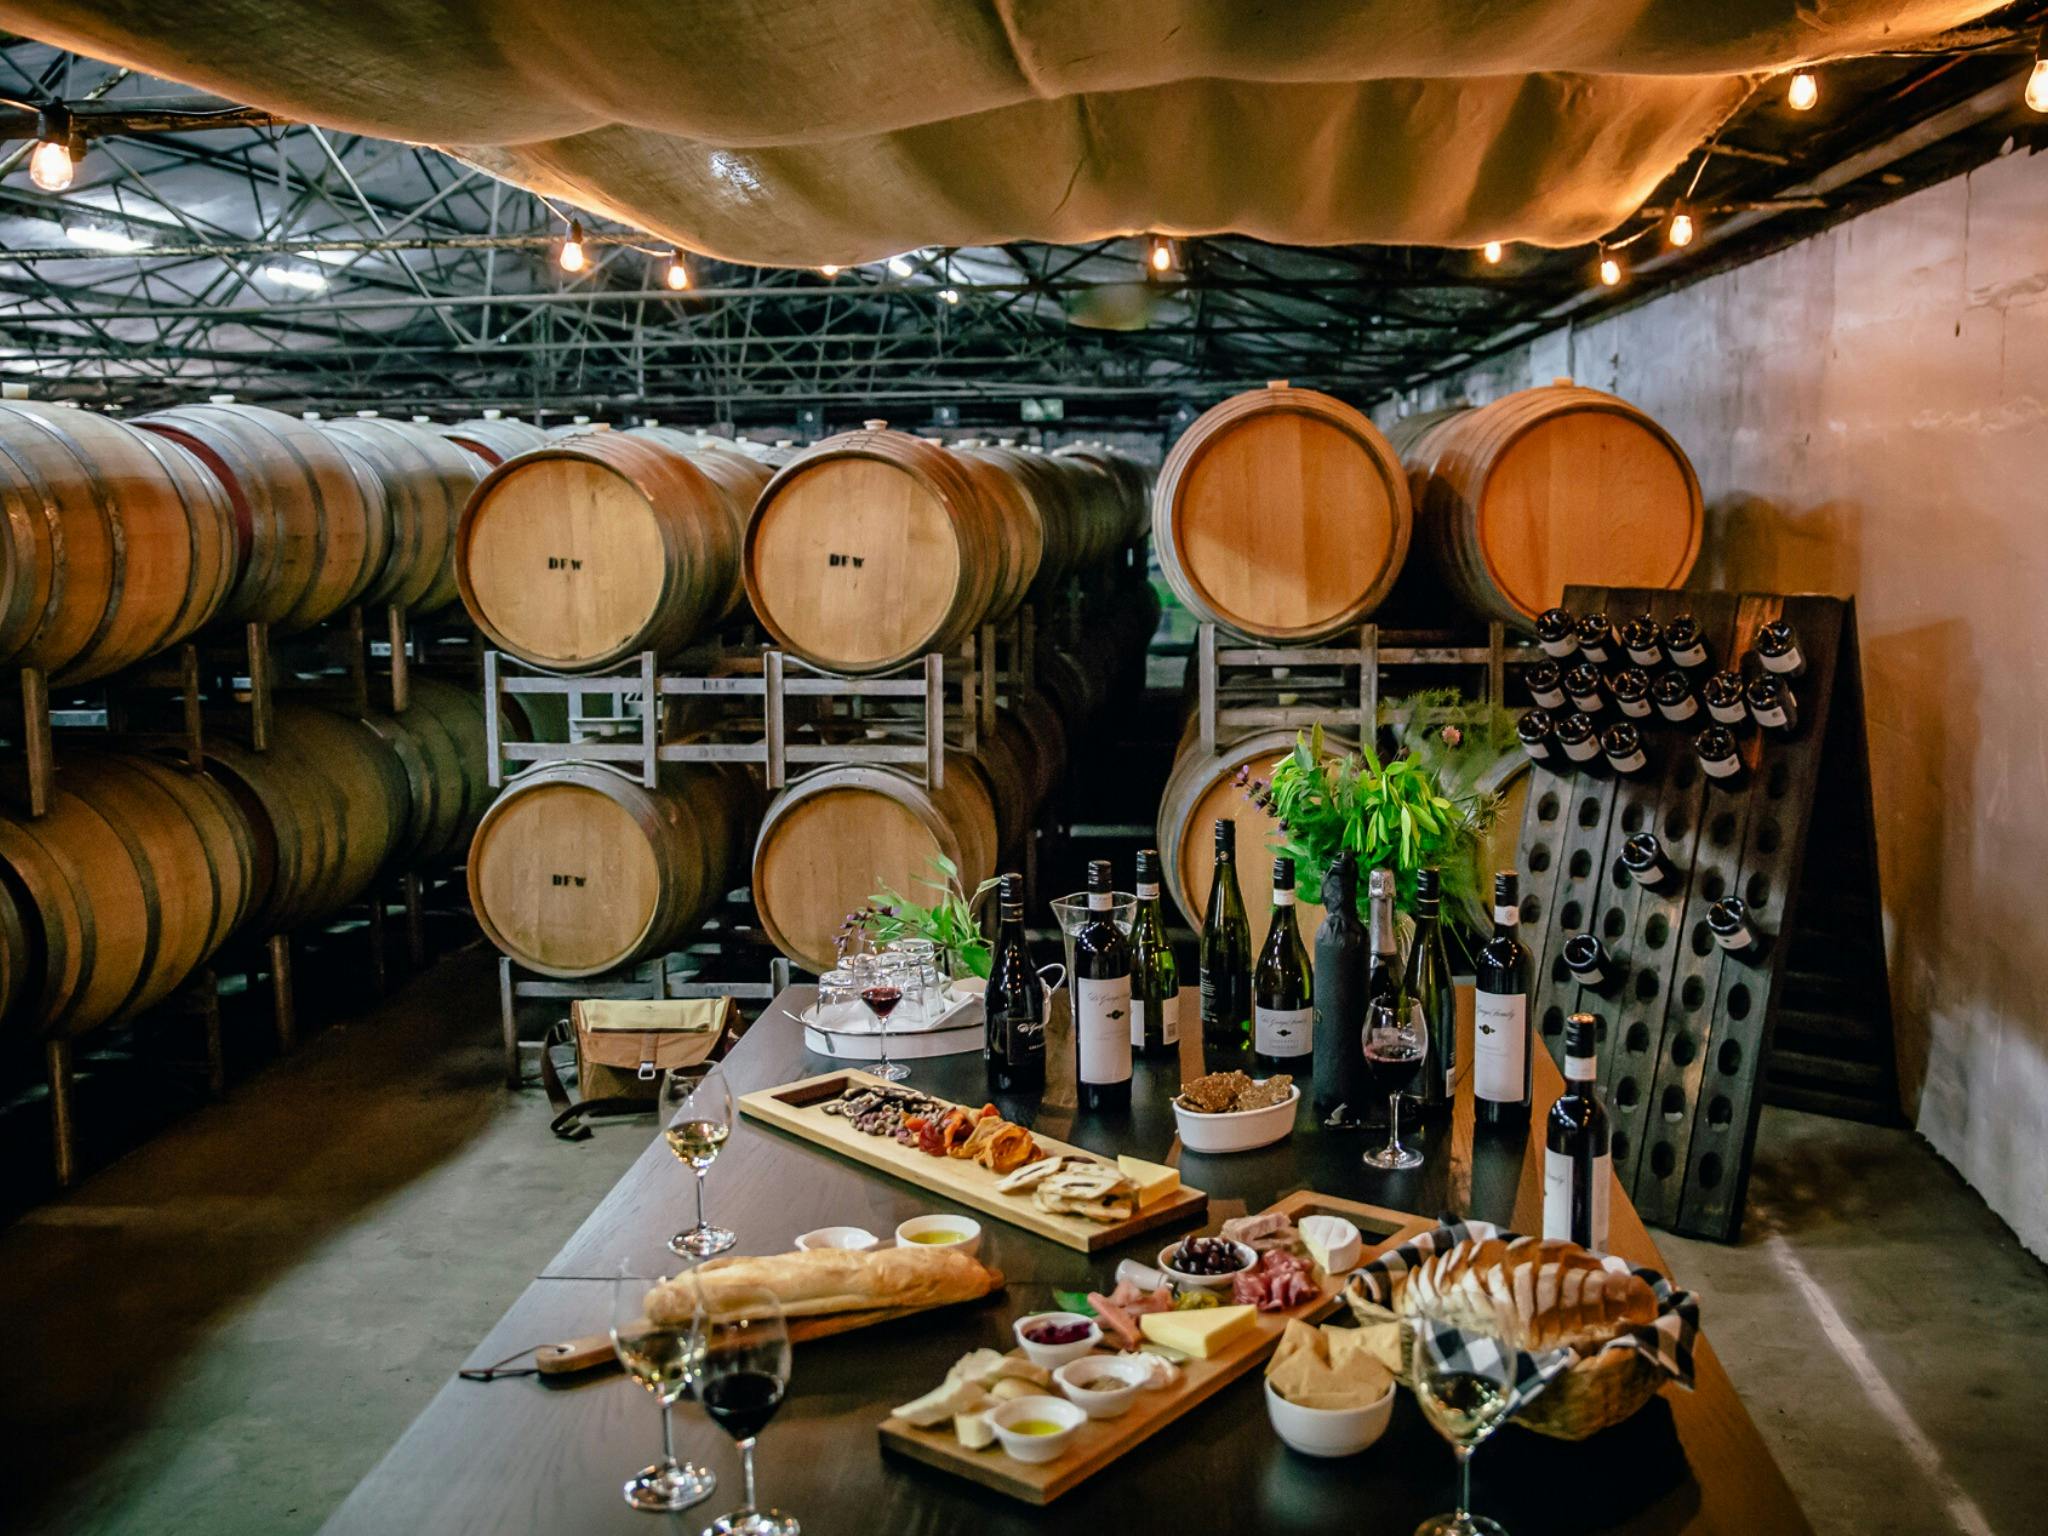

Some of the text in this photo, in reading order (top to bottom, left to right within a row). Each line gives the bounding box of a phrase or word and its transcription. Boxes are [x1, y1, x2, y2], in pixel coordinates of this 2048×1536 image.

[548, 556, 583, 571] DFW
[829, 553, 865, 568] DFW
[552, 873, 587, 887] DFW
